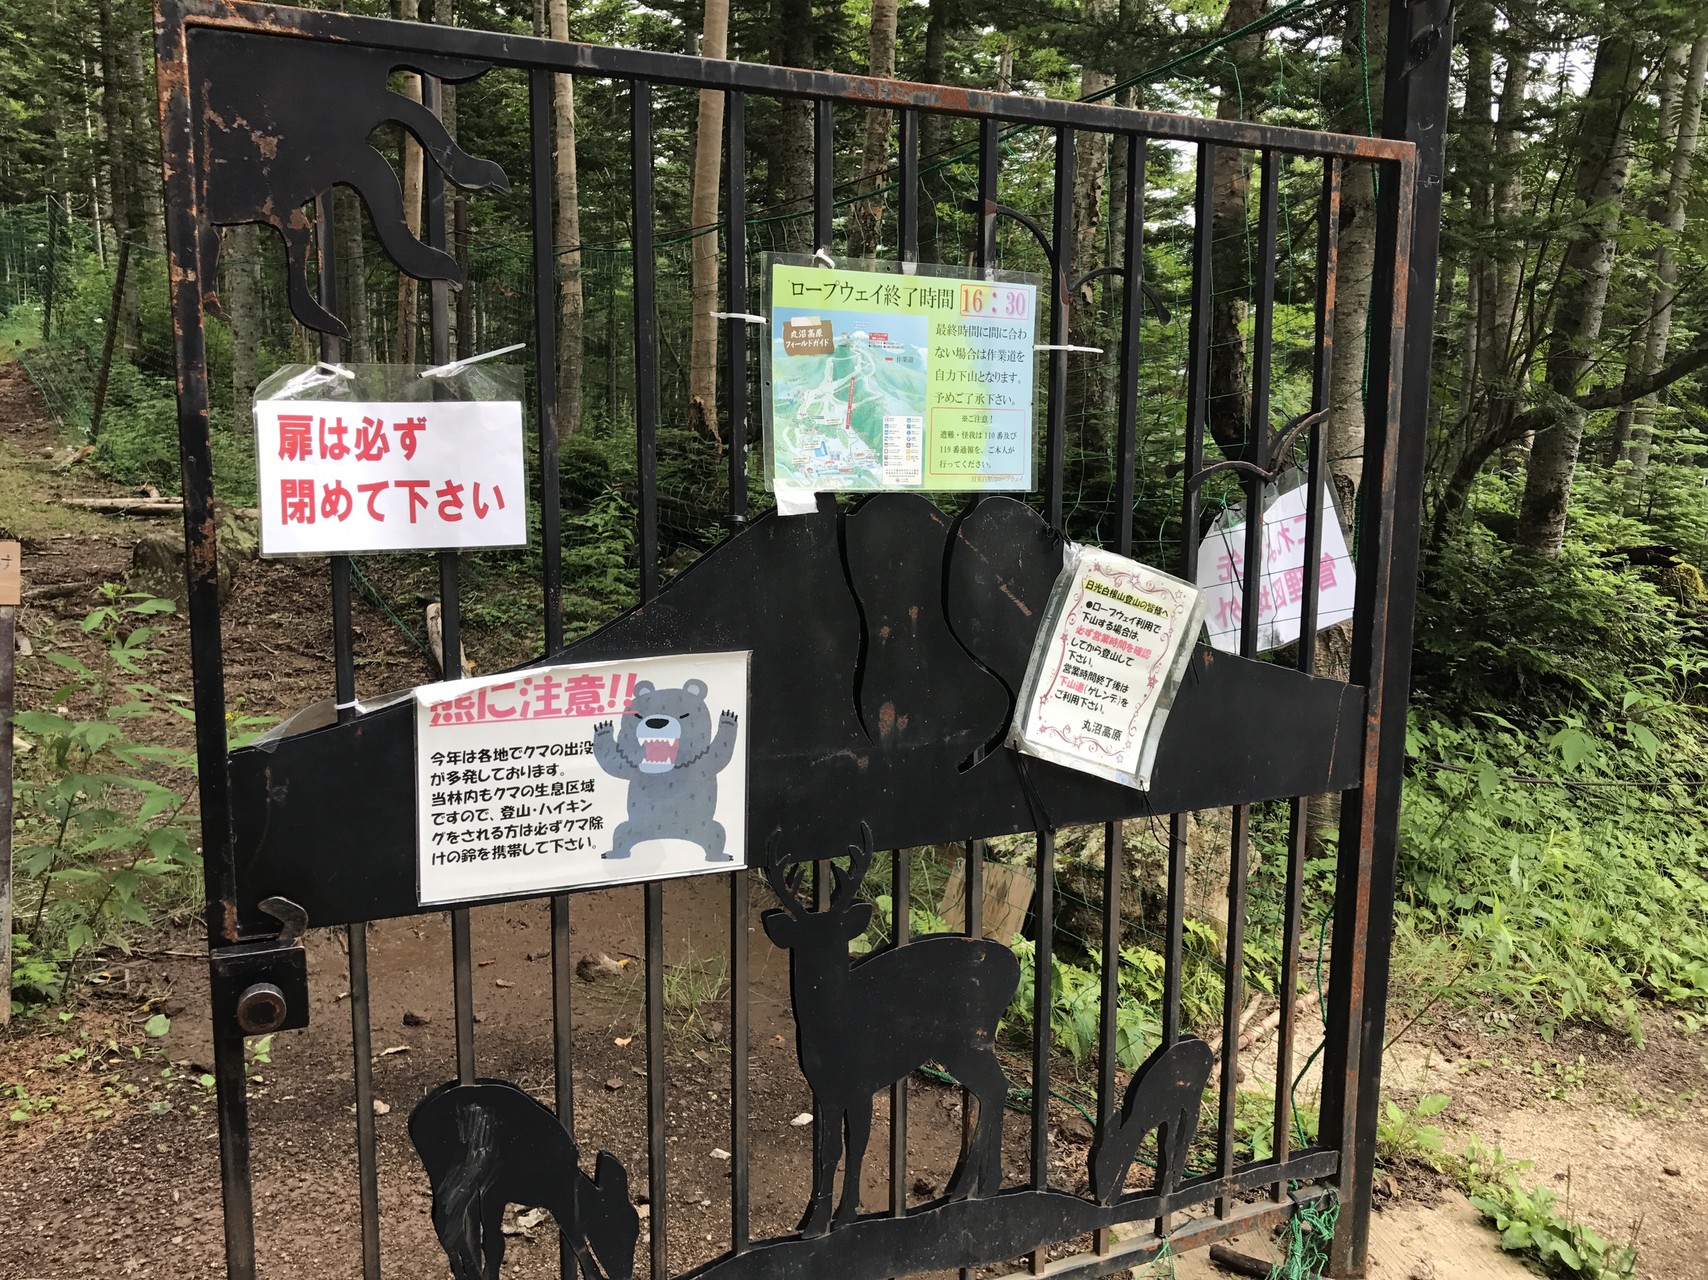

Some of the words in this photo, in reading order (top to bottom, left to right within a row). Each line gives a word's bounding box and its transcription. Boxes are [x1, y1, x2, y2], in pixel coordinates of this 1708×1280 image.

[791, 280, 954, 310] ロープウェイ終了時間
[785, 338, 830, 348] フィールドガイド
[790, 328, 823, 339] 丸沼高原
[935, 323, 1027, 340] 最終時間に間に合わ
[934, 345, 1025, 363] ない場合は作業道を
[935, 369, 1021, 384] 自力下山となります。
[935, 392, 1016, 406] 予めご了承下さい。
[277, 414, 427, 462] 扉は必ず
[939, 459, 992, 469] 行ってください。
[280, 478, 506, 526] 閉めて下さい
[1085, 579, 1169, 618] 日光白根山登山の皆様へ
[1082, 611, 1139, 641] 下山する場合は、
[1070, 637, 1135, 667] してから登山して
[1075, 624, 1153, 659] 必ず営業時間を確認
[1067, 650, 1094, 668] 下さい。
[1062, 663, 1129, 693] 営業時間終了後は
[1054, 689, 1105, 715] ご利用下さい。
[1081, 719, 1123, 741] 丸沼高原
[430, 741, 593, 766] 今年は各地でクマの出没
[430, 763, 565, 787] が多発しております。
[431, 779, 595, 806] 当林内もクマの生息区域
[431, 798, 593, 826] ですので、登山・ハイキン
[431, 816, 604, 846] グをされる方は必ずクマ除
[431, 838, 597, 866] けの鈴を携帯して下さい。
